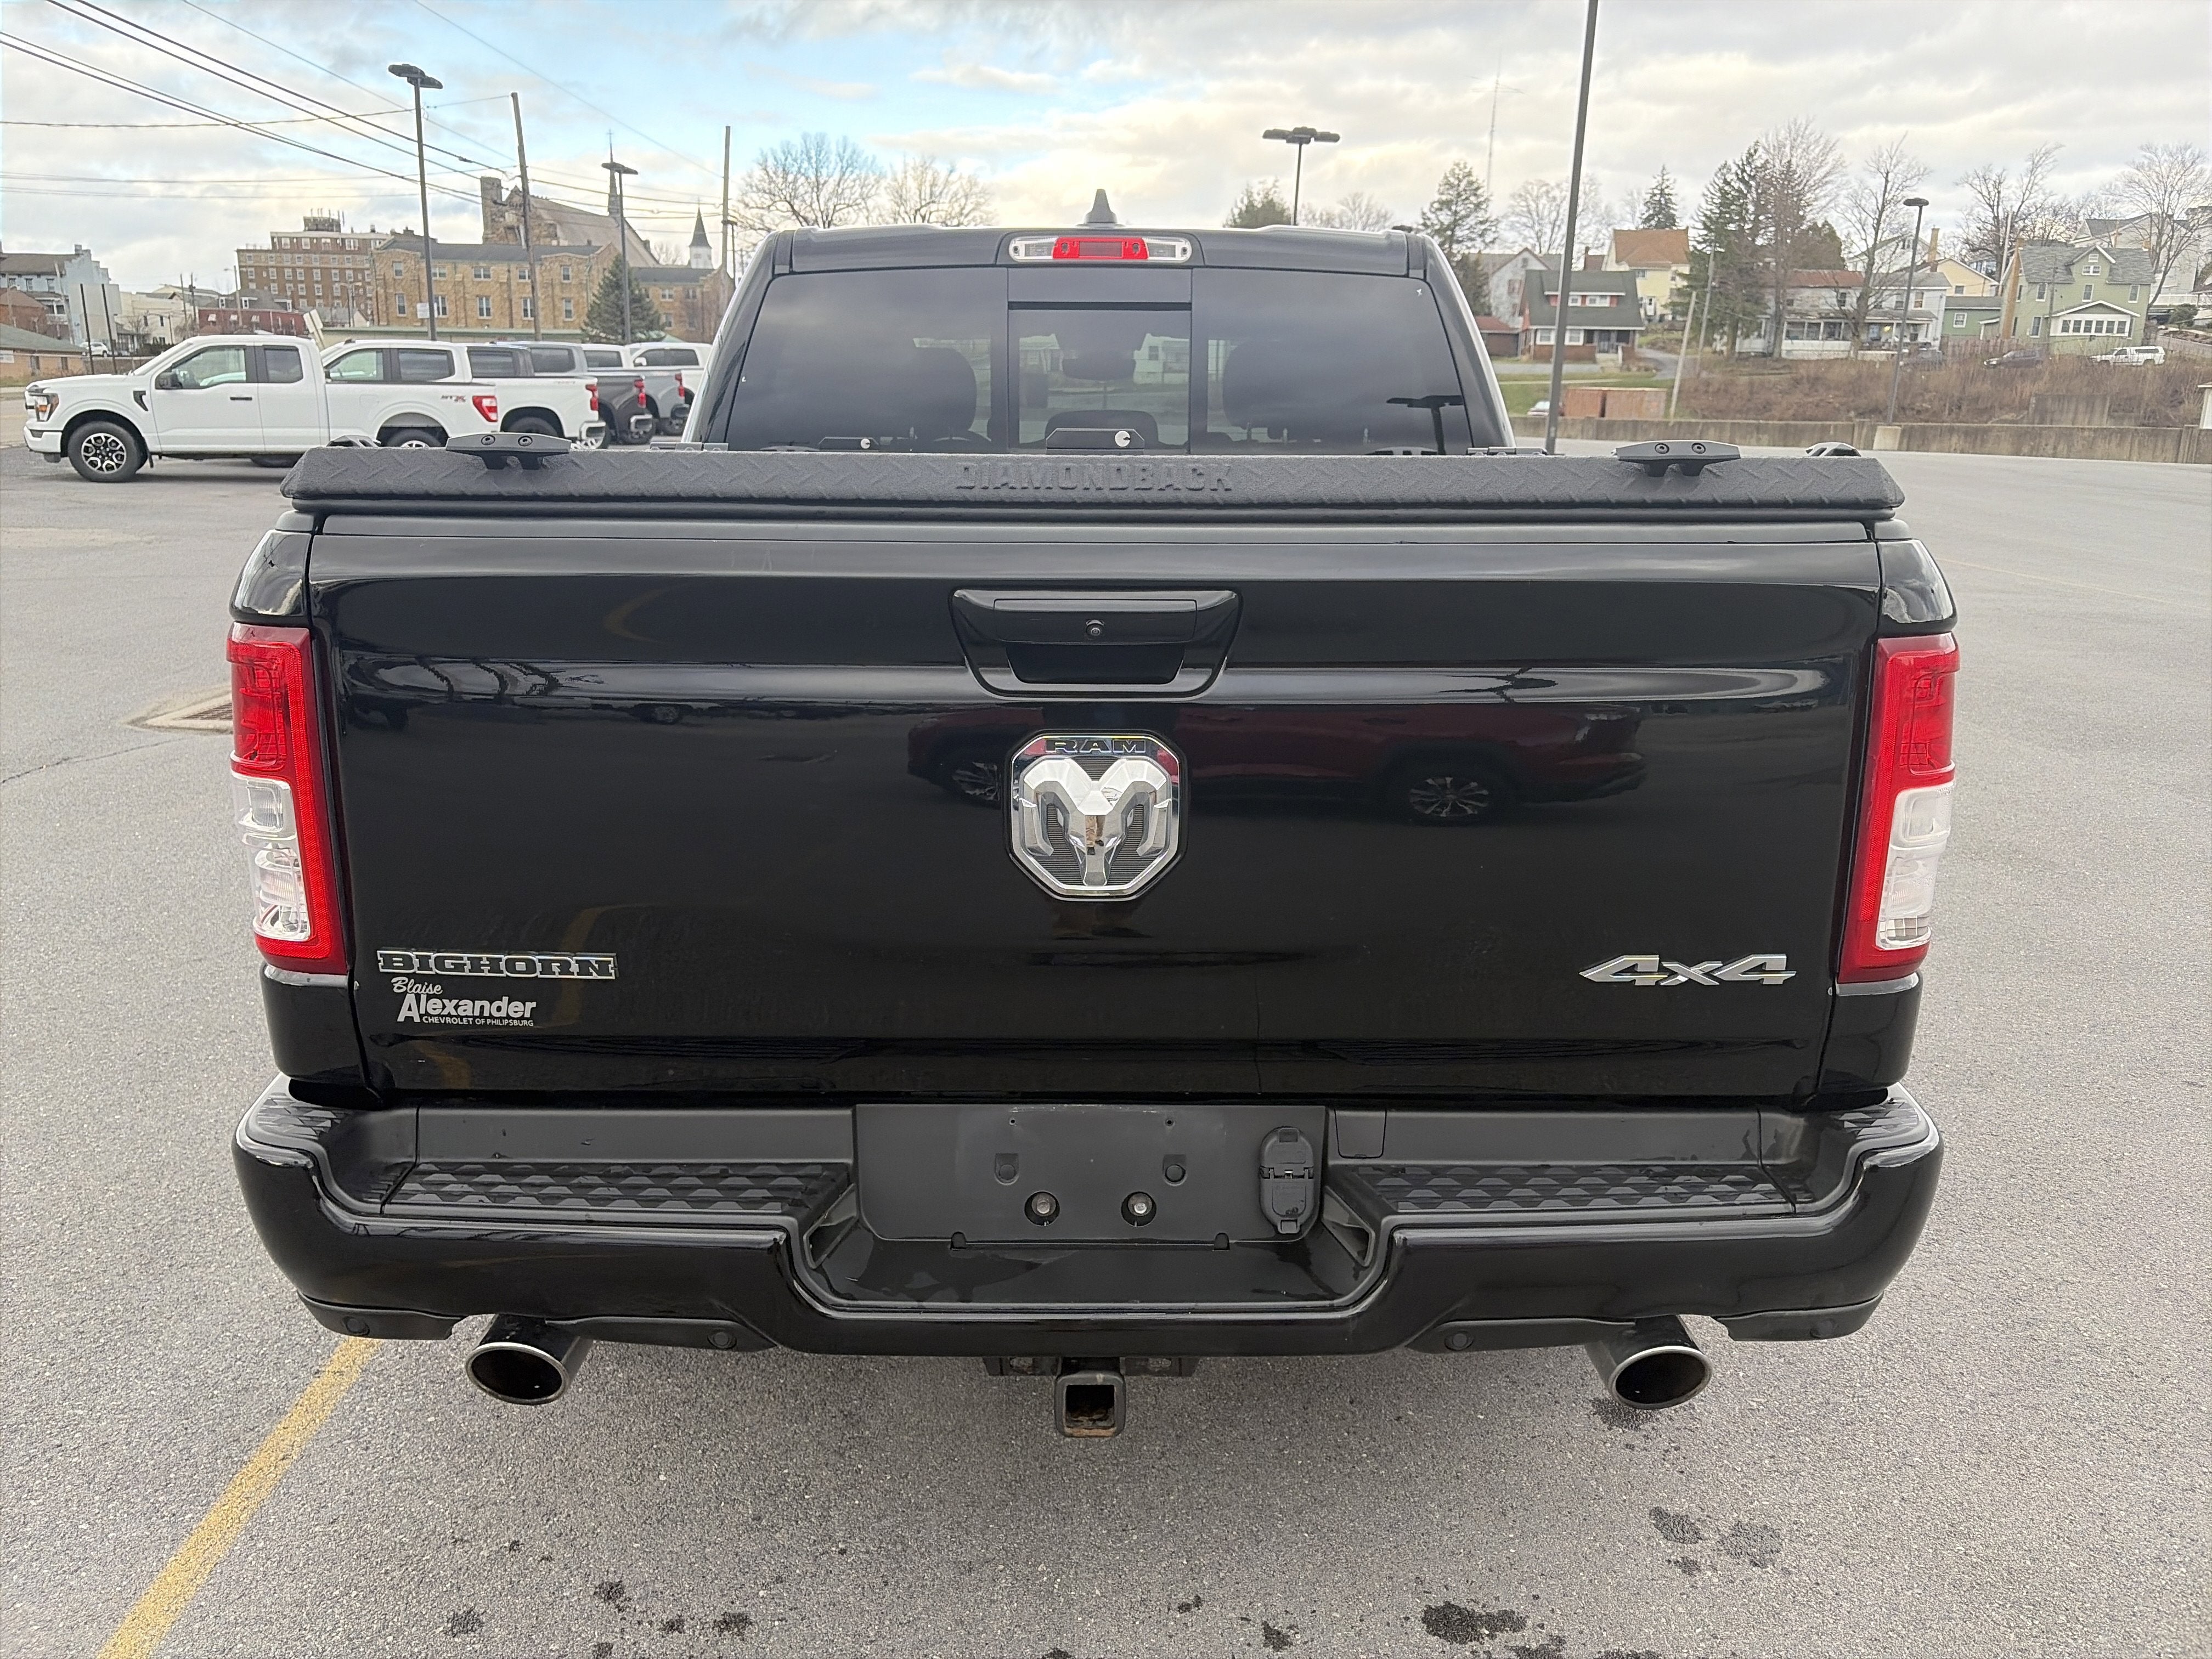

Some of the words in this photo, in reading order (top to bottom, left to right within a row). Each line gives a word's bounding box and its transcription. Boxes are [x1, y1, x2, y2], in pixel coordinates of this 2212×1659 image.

[956, 462, 1233, 492] DIAMONDBACK
[1045, 739, 1146, 753] RAM
[376, 949, 617, 980] BIGHORN
[1579, 953, 1797, 986] 4x4
[391, 976, 443, 995] Blaise
[397, 994, 537, 1023] Alexander
[422, 1016, 473, 1025] CHEVROLET
[486, 1018, 534, 1026] PHILIPSBURG
